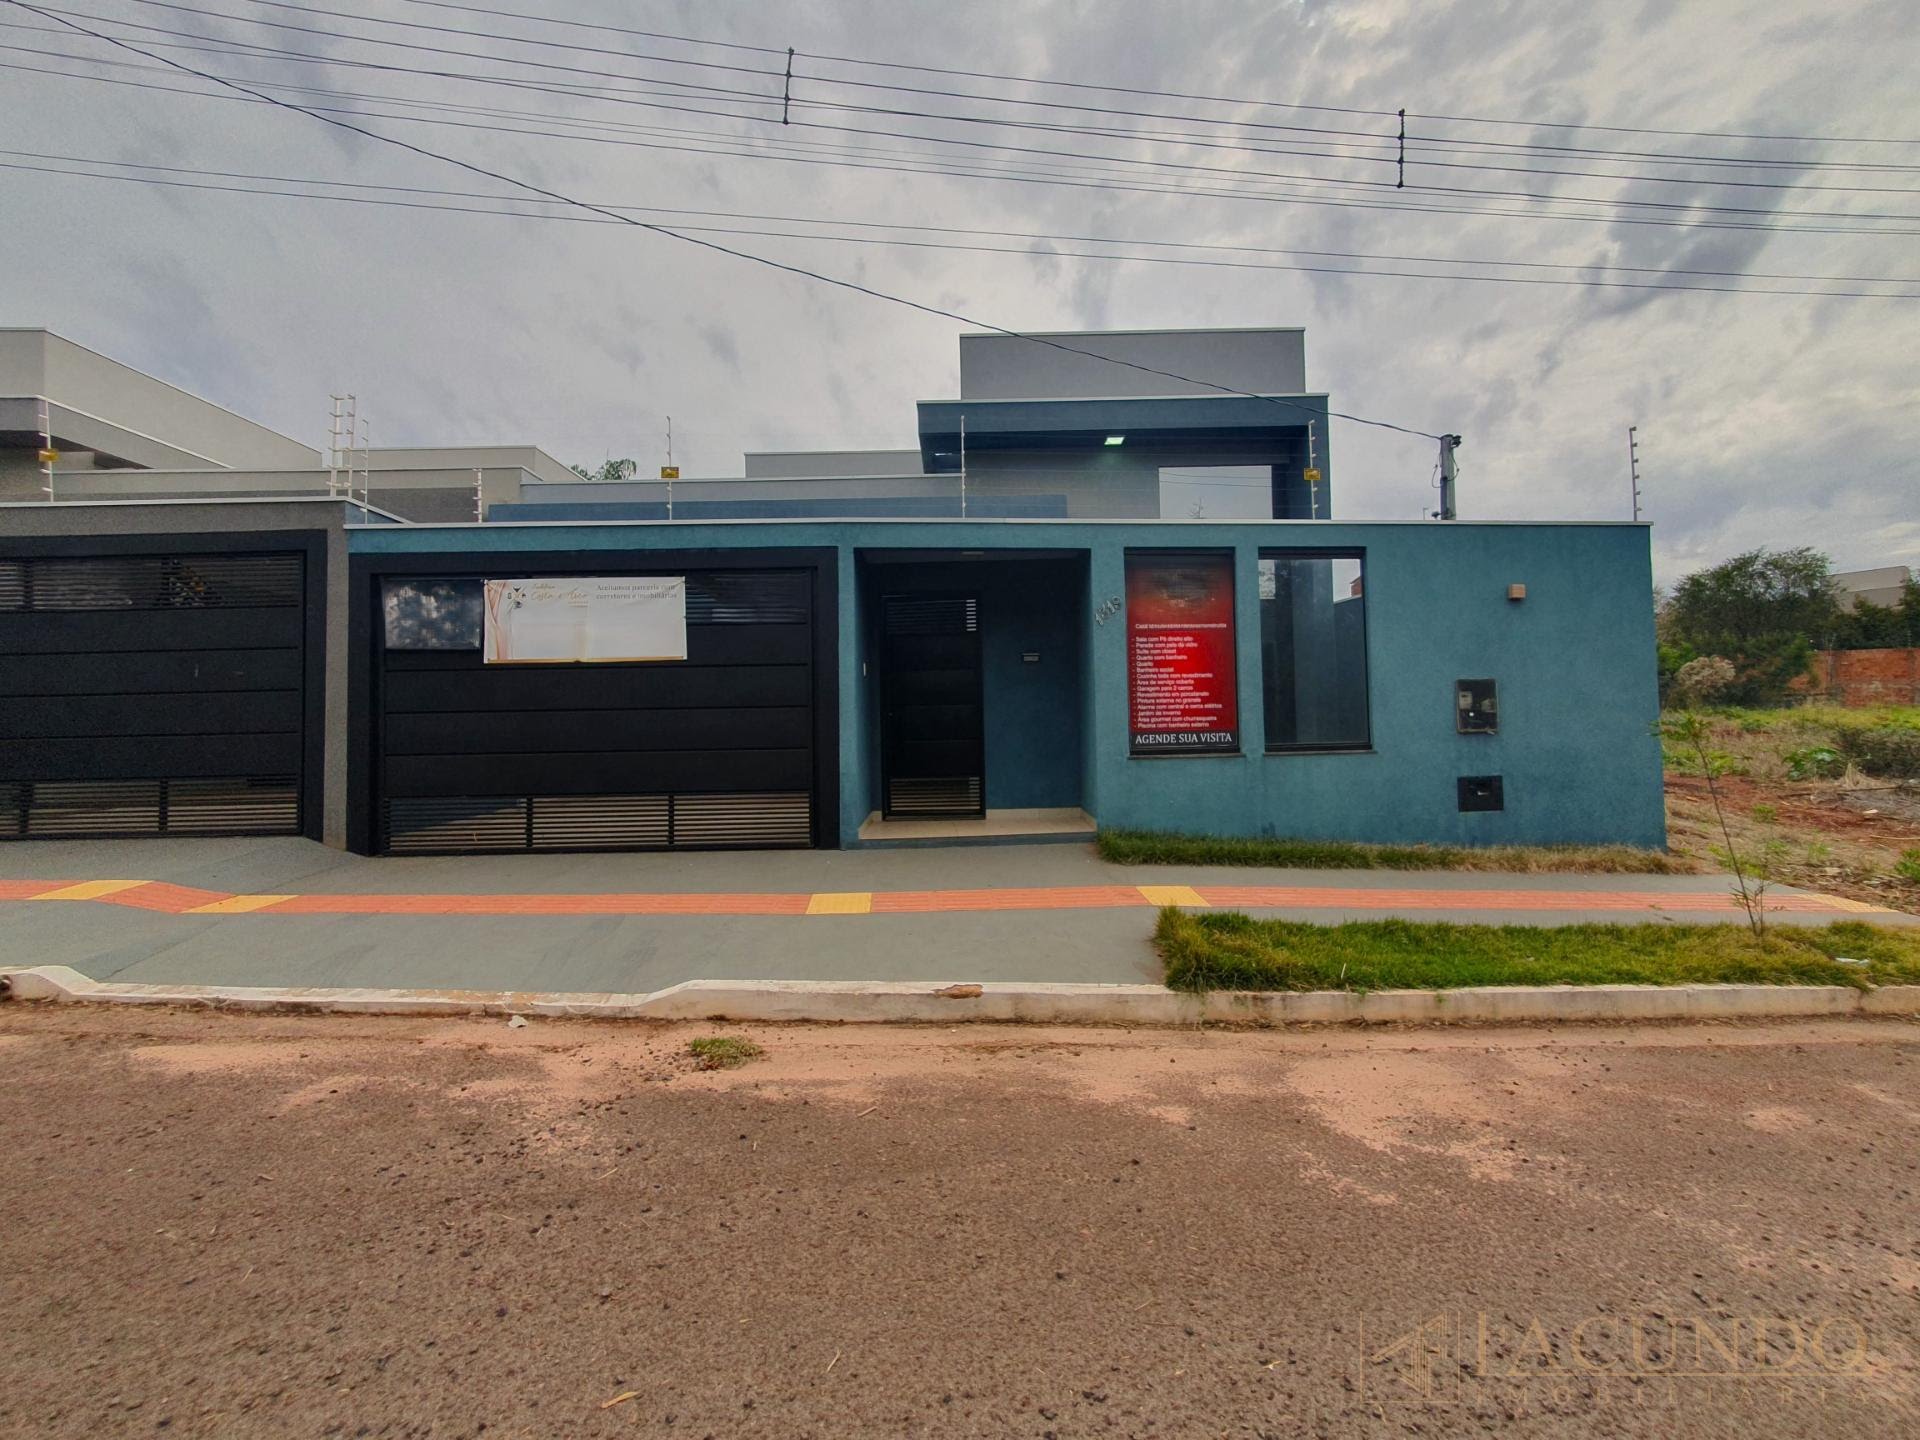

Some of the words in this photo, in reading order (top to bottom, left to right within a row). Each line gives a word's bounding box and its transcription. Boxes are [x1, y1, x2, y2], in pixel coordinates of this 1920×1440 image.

[1135, 733, 1177, 744] AGENDE
[1179, 733, 1198, 743] SUA
[1200, 732, 1232, 742] VISITA
